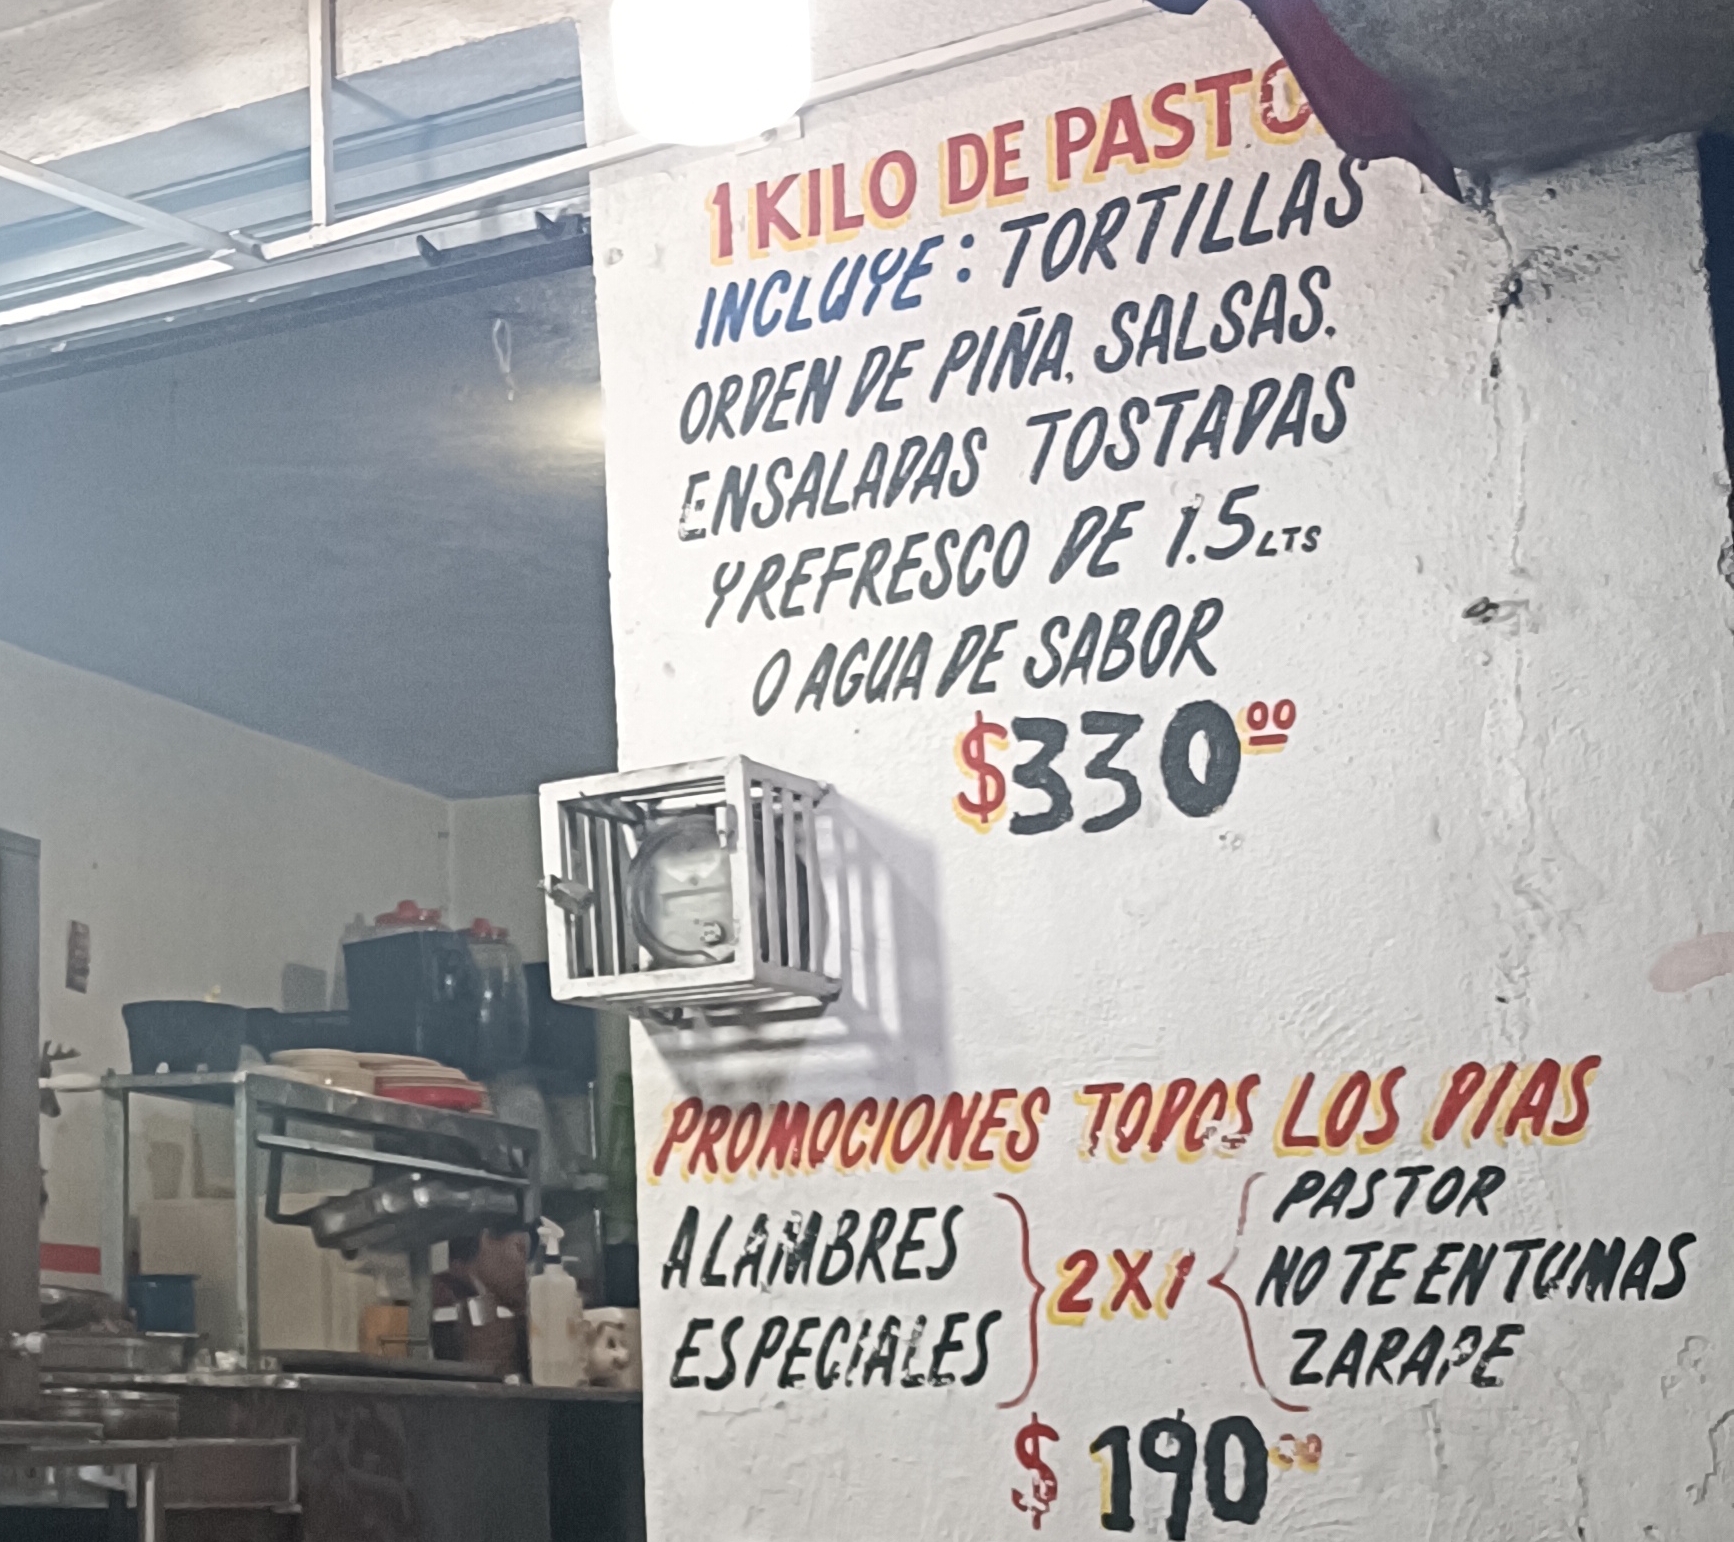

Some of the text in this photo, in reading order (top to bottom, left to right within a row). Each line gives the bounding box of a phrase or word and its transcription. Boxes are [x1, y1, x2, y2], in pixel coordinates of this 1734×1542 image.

[754, 149, 918, 251] KILO
[946, 119, 1029, 206] DE
[1053, 57, 1314, 181] PASTO
[1000, 157, 1370, 289] TORTILLAS
[677, 365, 1356, 543] ENSALADAS TOSTADAS
[679, 354, 842, 445] ORDEN
[844, 339, 926, 419] DE
[1048, 499, 1145, 585] DE
[752, 596, 1224, 718] O AGUA DE SABOR
[652, 1053, 1603, 1178] PROMOCIONES TODOS LOS DIAS
[661, 1163, 1506, 1315] ALAMBRES 2X1 PASTOR
[668, 1309, 1003, 1391] ESPECIALES
[1255, 1244, 1332, 1307] NO
